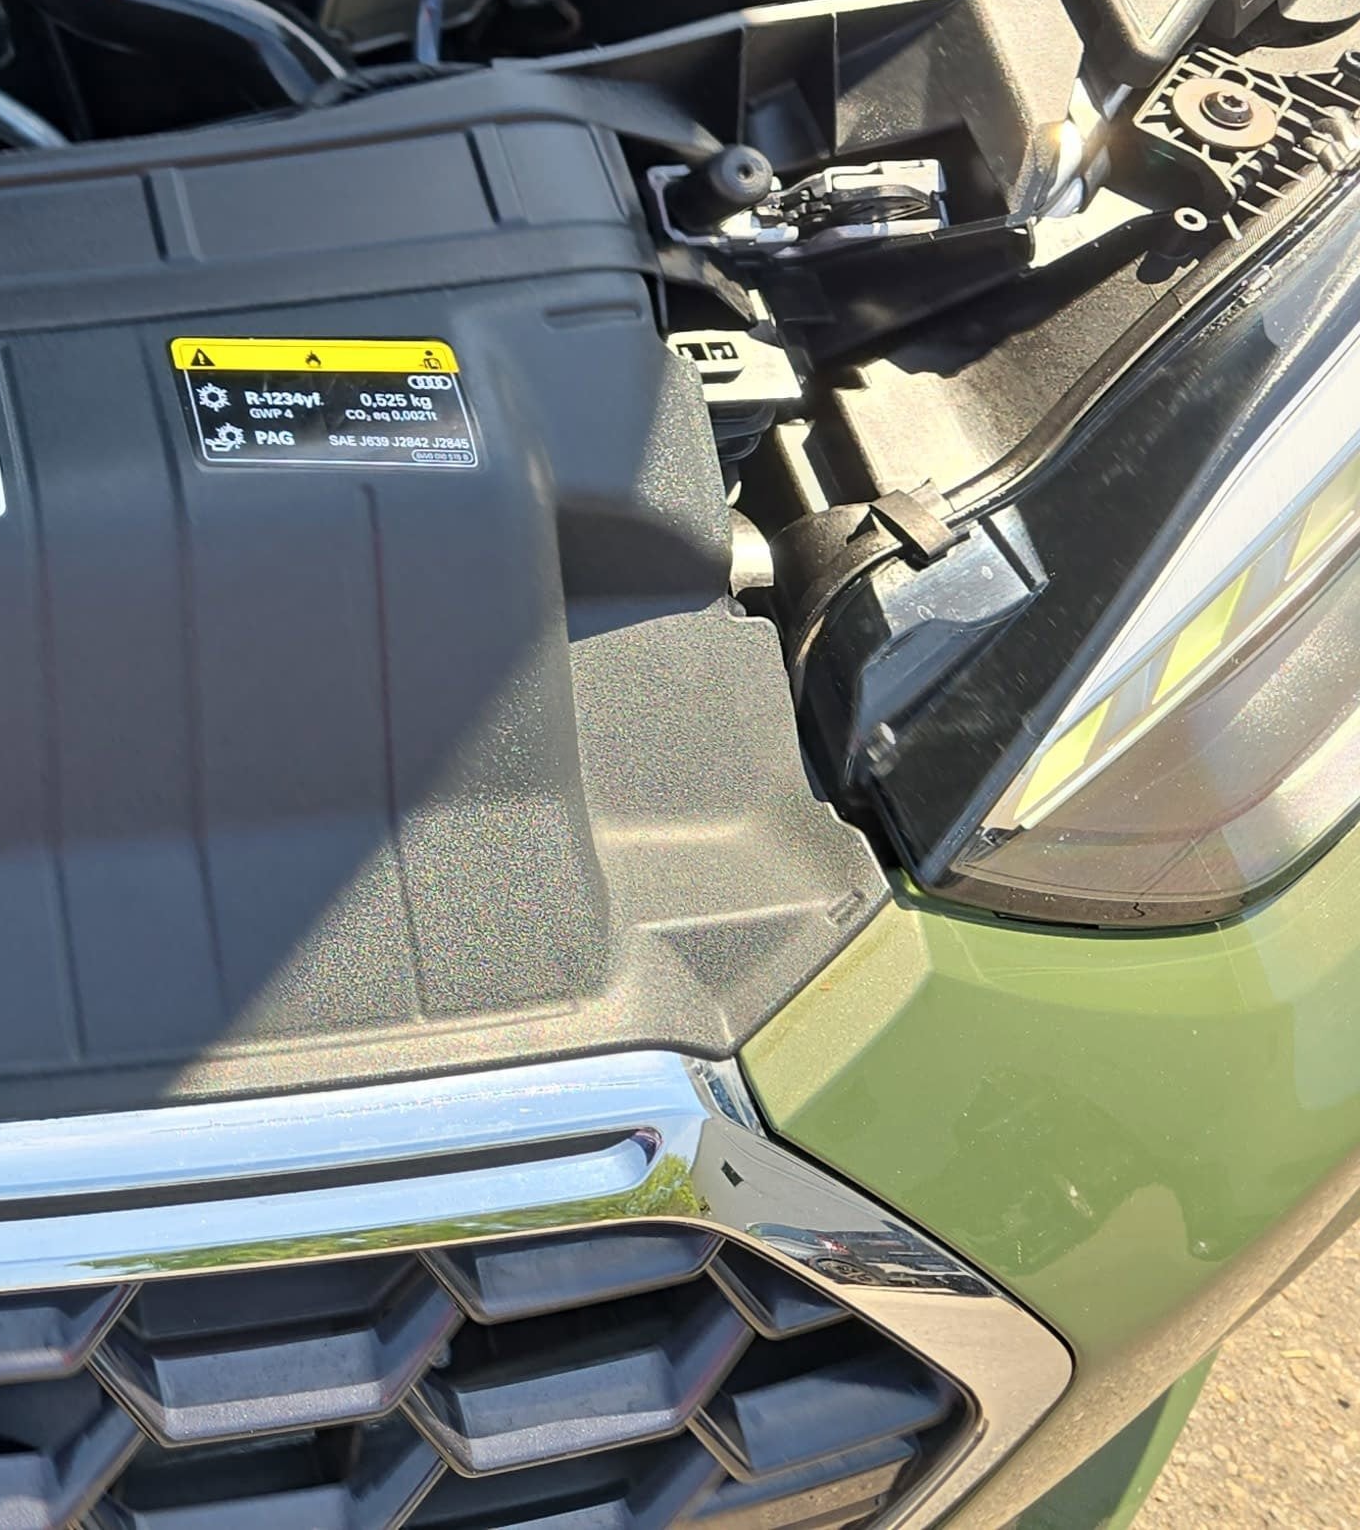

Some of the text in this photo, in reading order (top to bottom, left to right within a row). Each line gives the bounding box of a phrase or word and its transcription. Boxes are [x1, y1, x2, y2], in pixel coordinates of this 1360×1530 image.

[360, 393, 433, 410] 0,525 kg
[249, 408, 294, 419] GWP 4
[373, 412, 391, 422] eq
[254, 430, 296, 446] PAG
[329, 434, 470, 449] SAE J639 J2842 J2845
